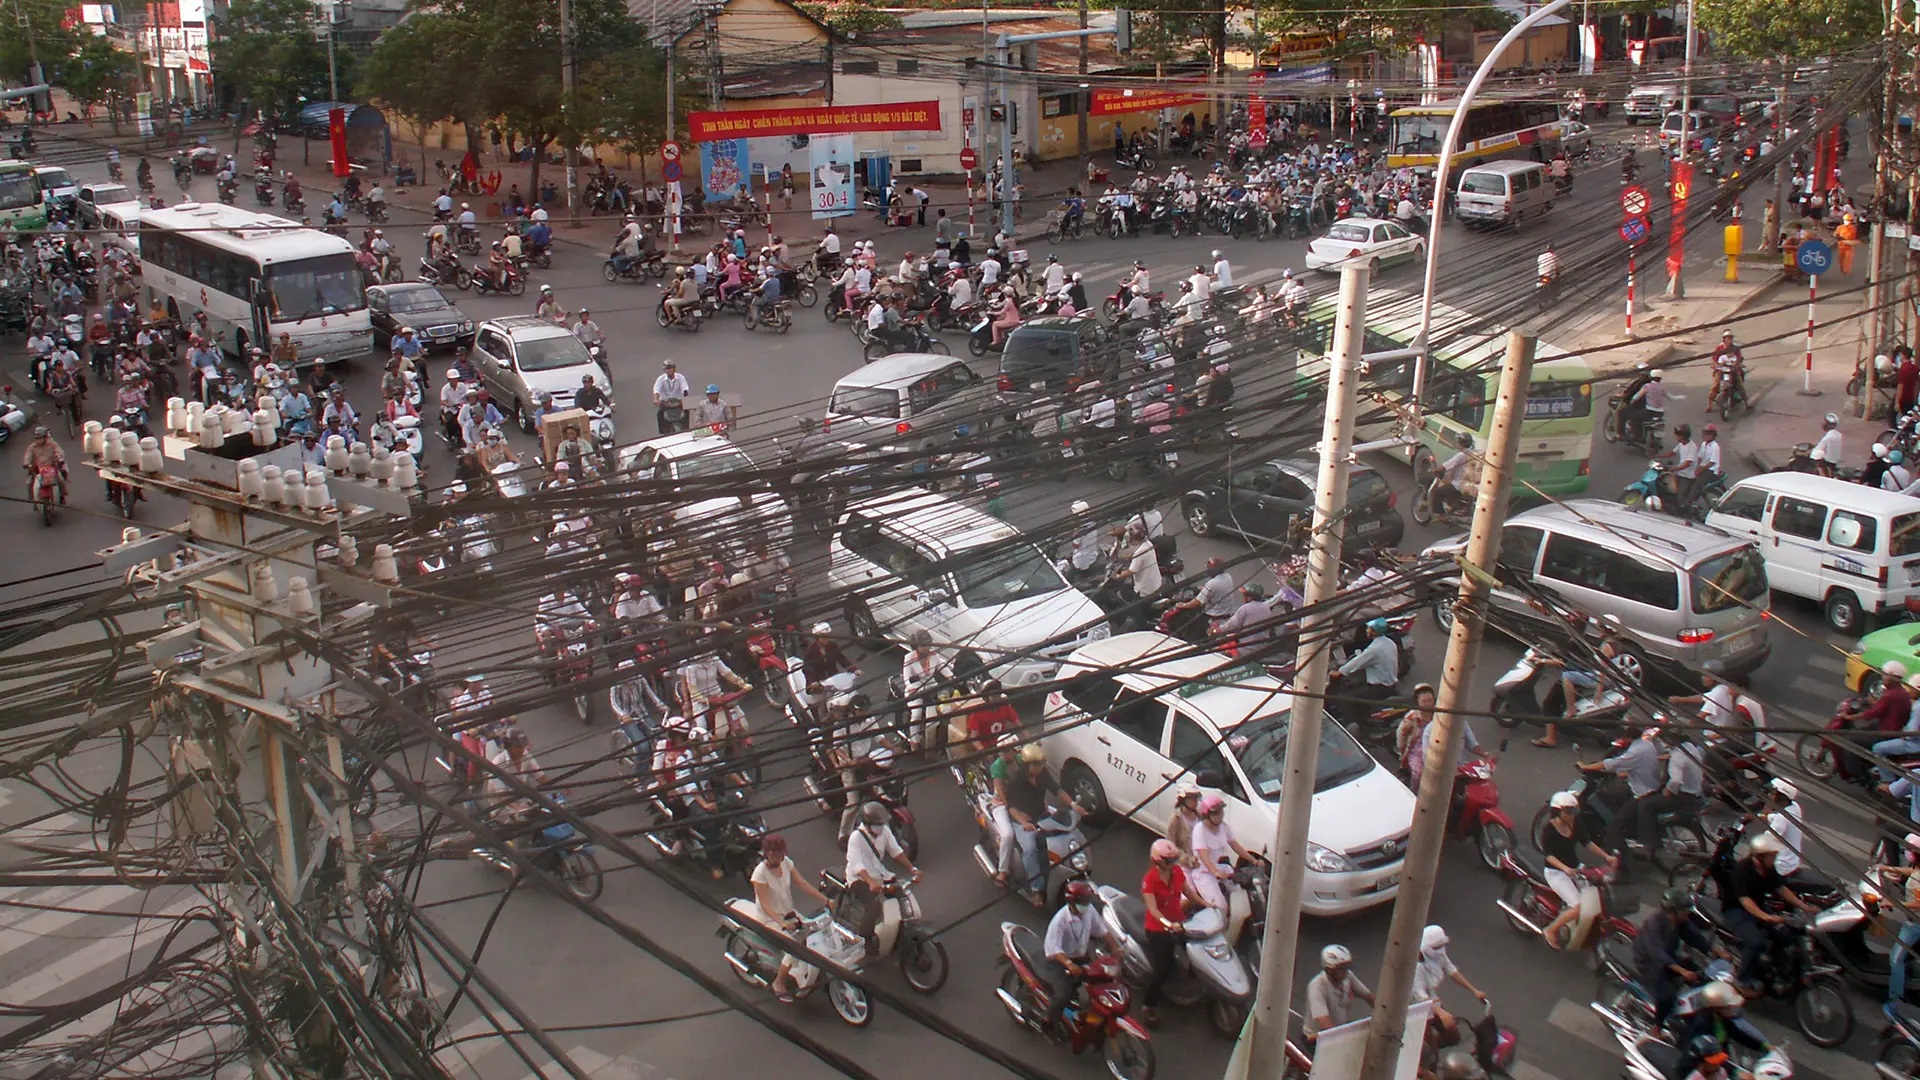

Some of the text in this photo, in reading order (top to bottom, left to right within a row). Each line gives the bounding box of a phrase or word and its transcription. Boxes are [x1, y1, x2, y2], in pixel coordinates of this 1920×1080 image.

[860, 112, 872, 123] LAO
[890, 111, 901, 122] 1/5
[1124, 763, 1135, 777] 27
[1136, 770, 1147, 784] 27
